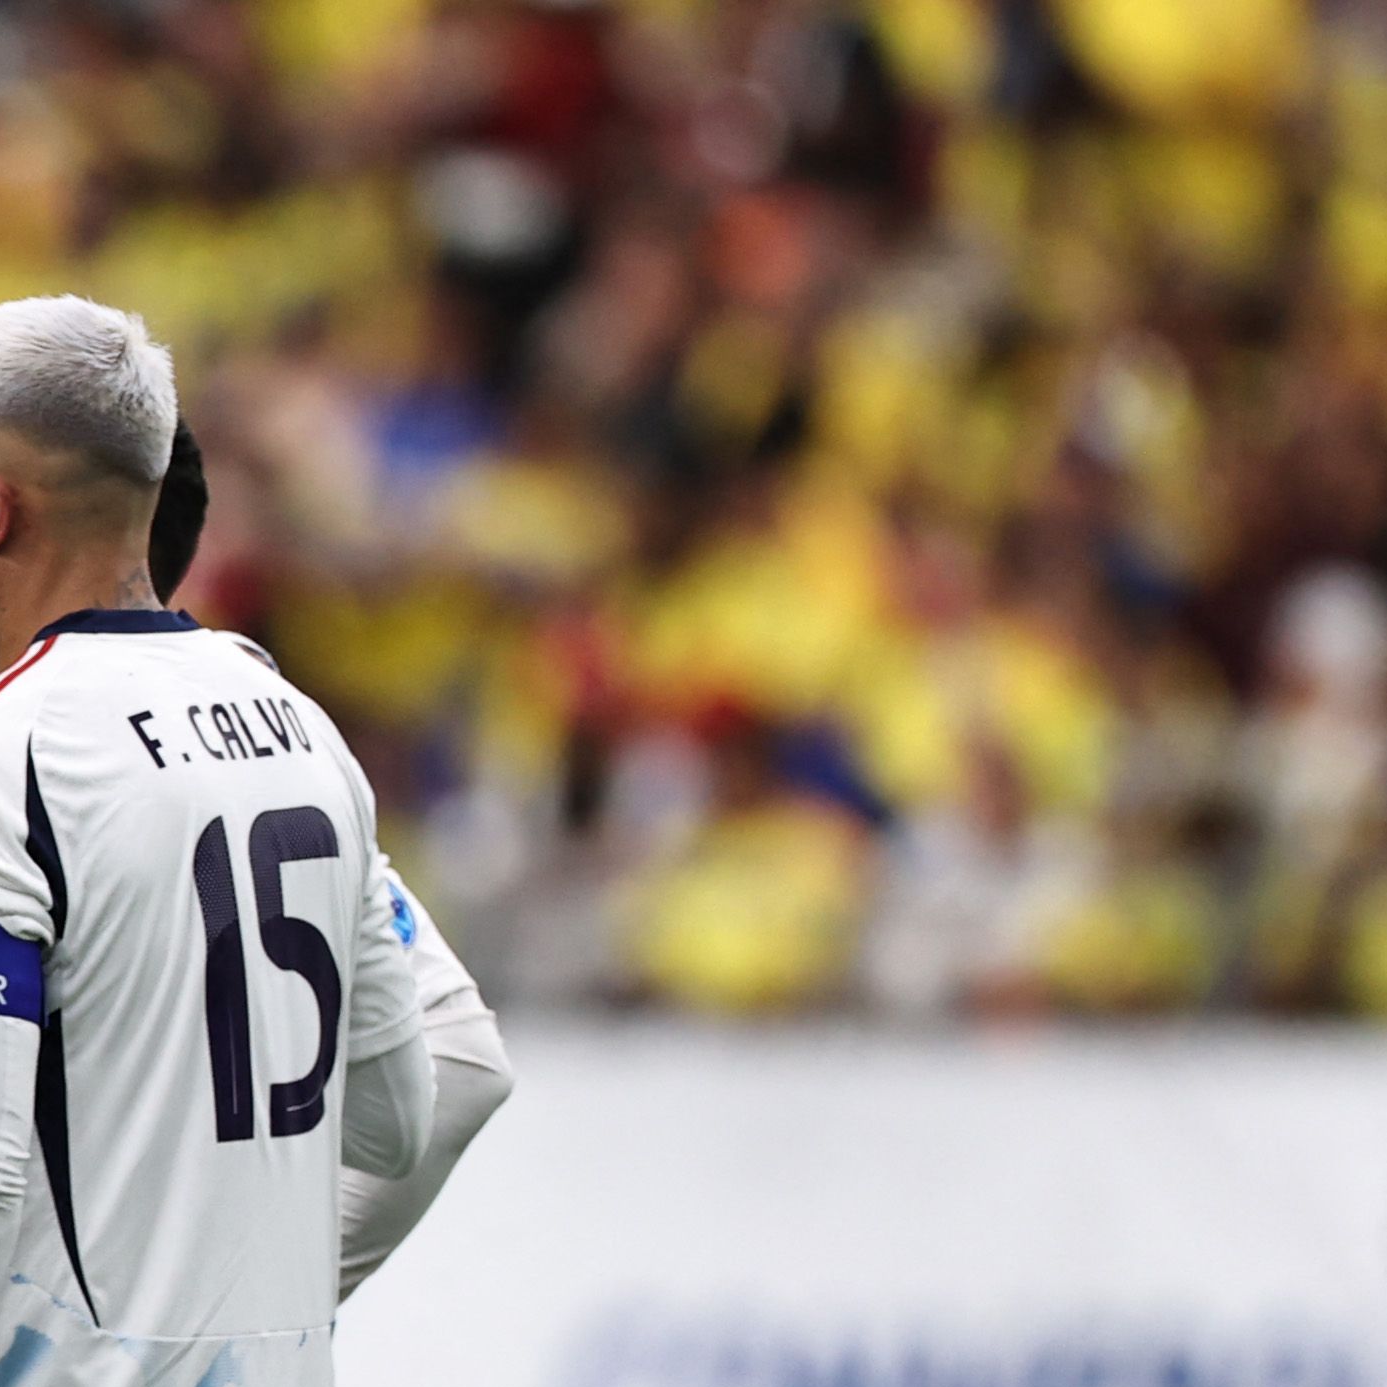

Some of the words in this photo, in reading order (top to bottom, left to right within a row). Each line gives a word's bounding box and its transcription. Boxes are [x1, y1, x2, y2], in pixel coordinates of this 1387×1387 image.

[128, 711, 191, 769] F.
[188, 698, 312, 761] CALVO
[194, 805, 342, 1144] 15
